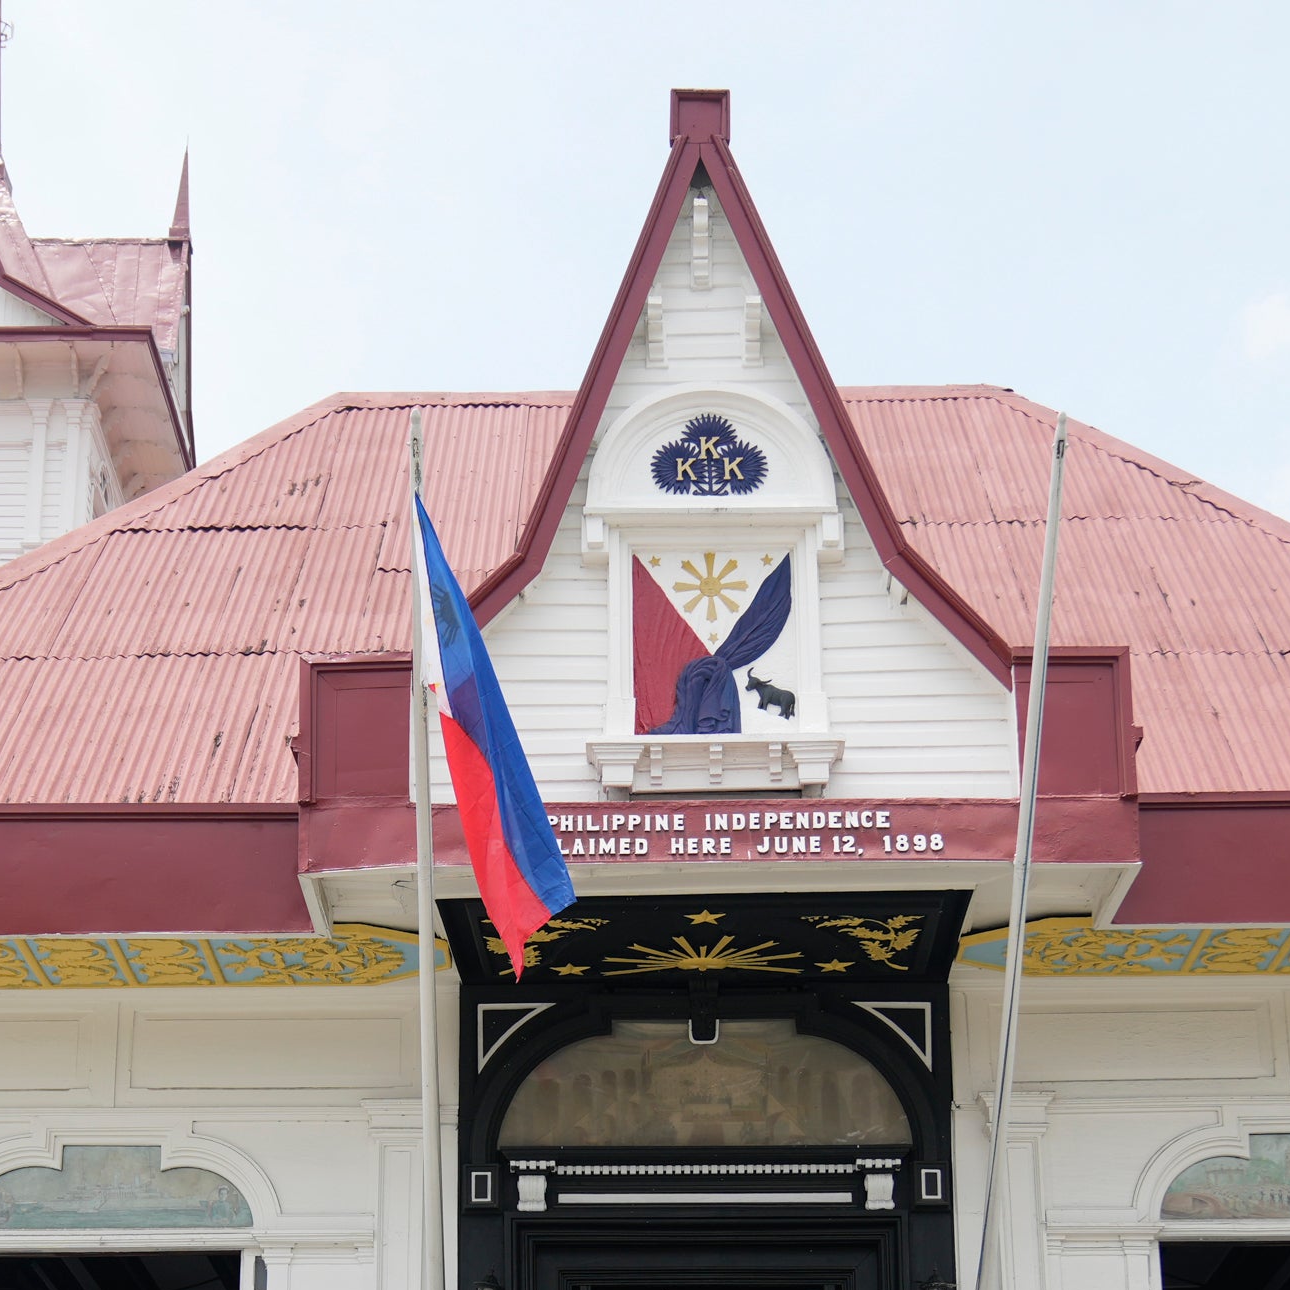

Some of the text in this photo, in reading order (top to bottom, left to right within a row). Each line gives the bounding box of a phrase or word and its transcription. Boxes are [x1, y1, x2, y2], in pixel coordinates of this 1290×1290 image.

[699, 436, 720, 459] K
[675, 457, 745, 481] K K
[547, 811, 891, 832] PHILIPPINE INDEPENDENCE
[556, 833, 944, 856] LAIMED HERE JUNE 12, 1898
